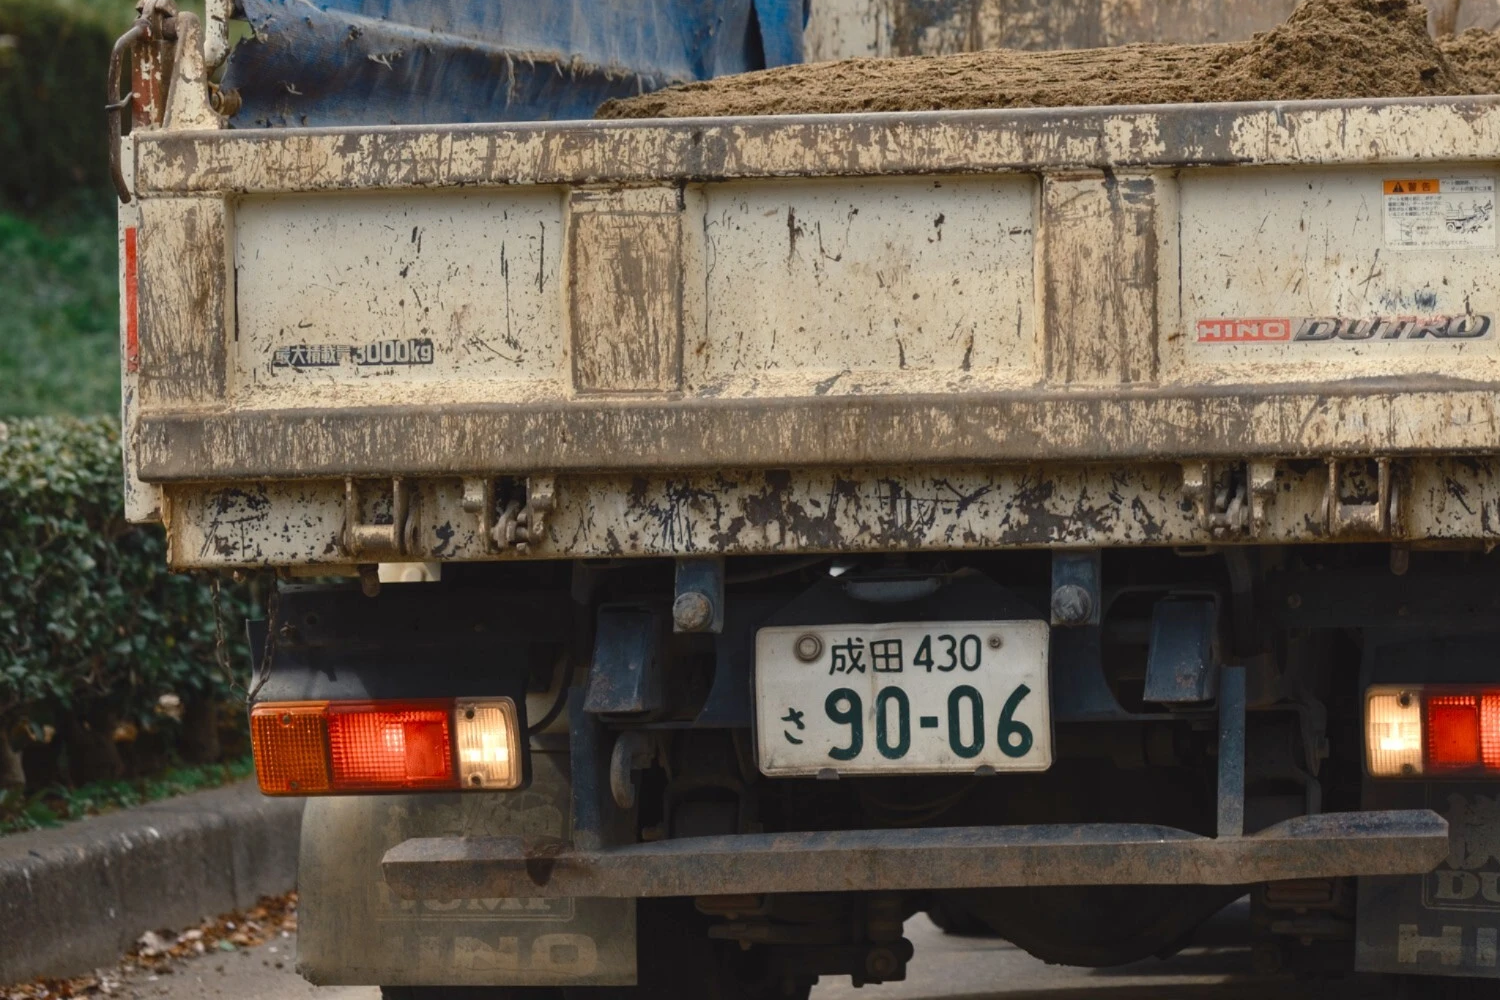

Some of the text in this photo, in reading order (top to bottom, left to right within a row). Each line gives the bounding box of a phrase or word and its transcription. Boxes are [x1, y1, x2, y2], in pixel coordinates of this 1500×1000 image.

[1199, 315, 1492, 341] HINO DUTRO
[354, 340, 433, 365] 3000kg
[828, 634, 982, 675] 成田 430
[781, 684, 1034, 760] さ 90-06
